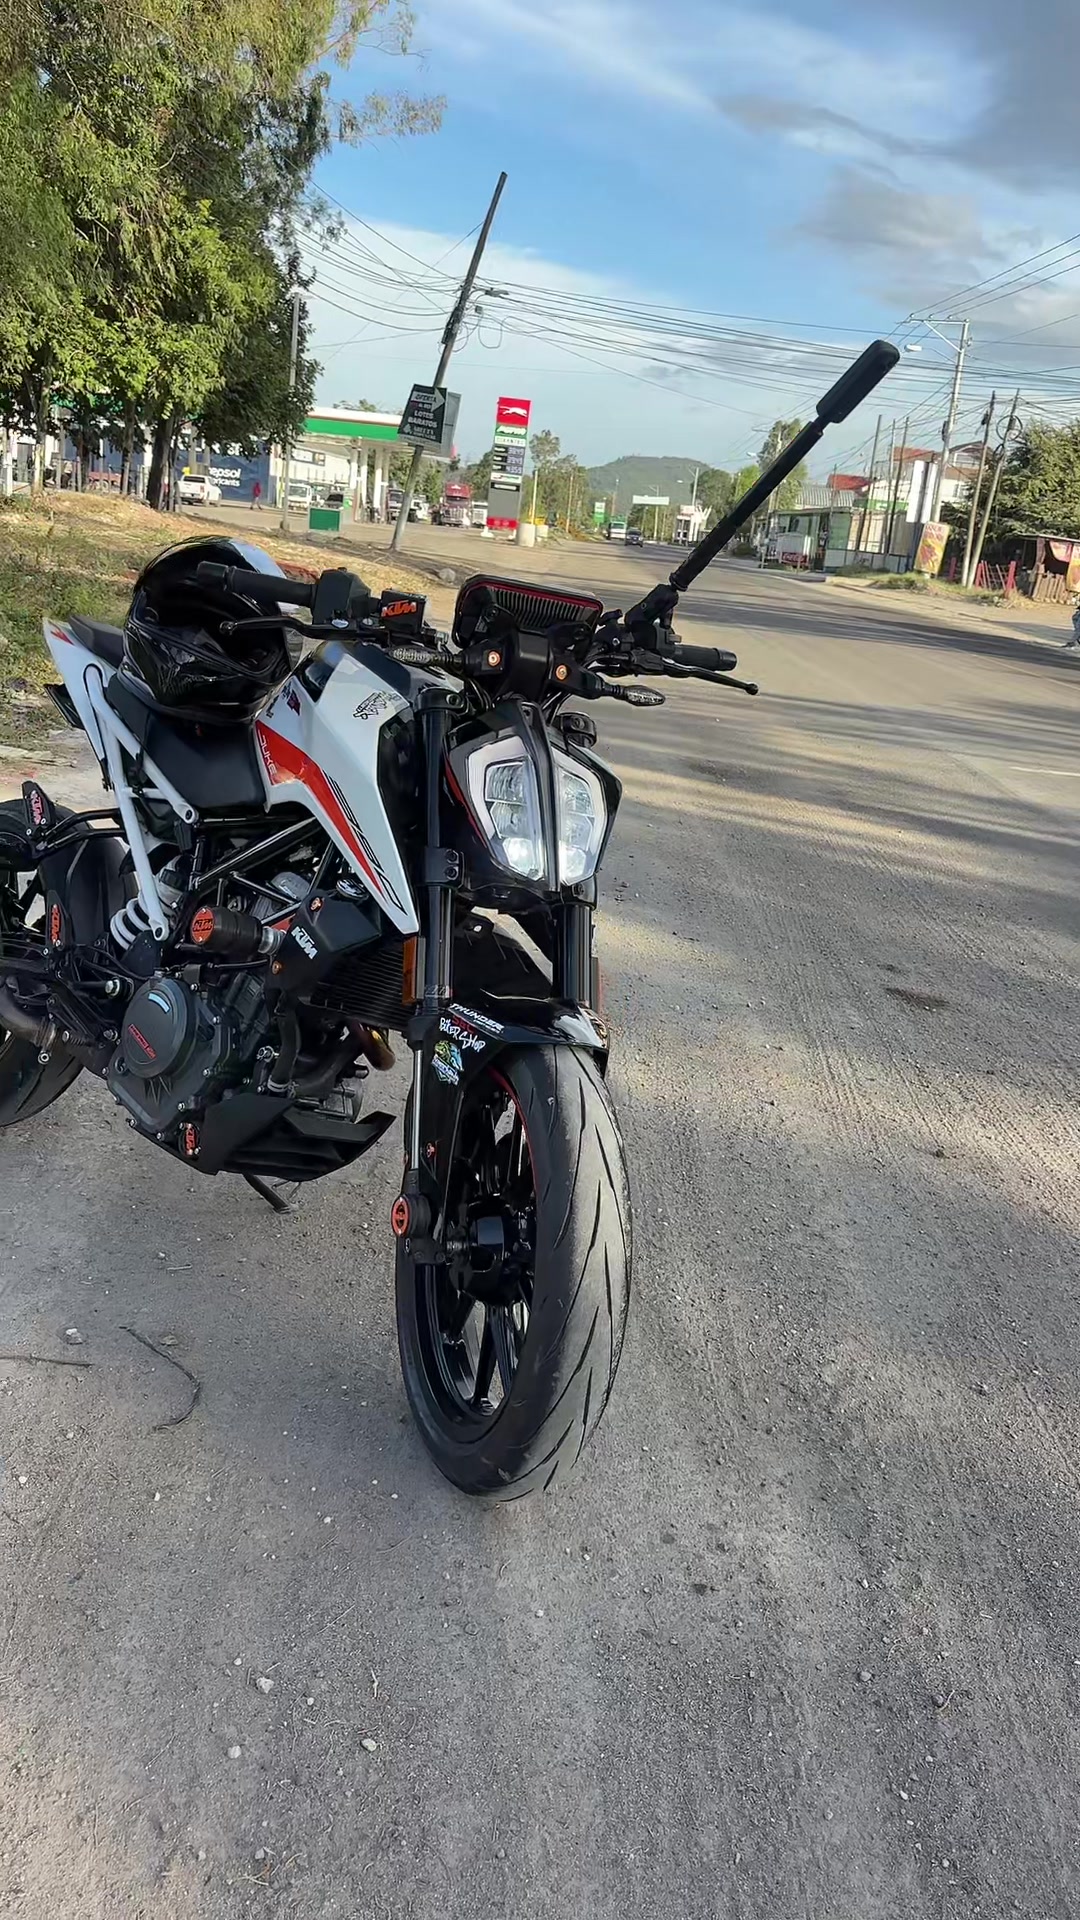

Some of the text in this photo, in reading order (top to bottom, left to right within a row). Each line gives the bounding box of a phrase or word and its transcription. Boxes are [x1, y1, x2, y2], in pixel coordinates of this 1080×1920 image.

[407, 416, 437, 428] BARATOS
[414, 410, 434, 419] LOTES
[381, 600, 417, 617] KTM
[257, 729, 277, 775] DUKE
[322, 769, 408, 916] 390
[291, 926, 318, 960] KTM
[449, 1003, 505, 1031] THUNDER
